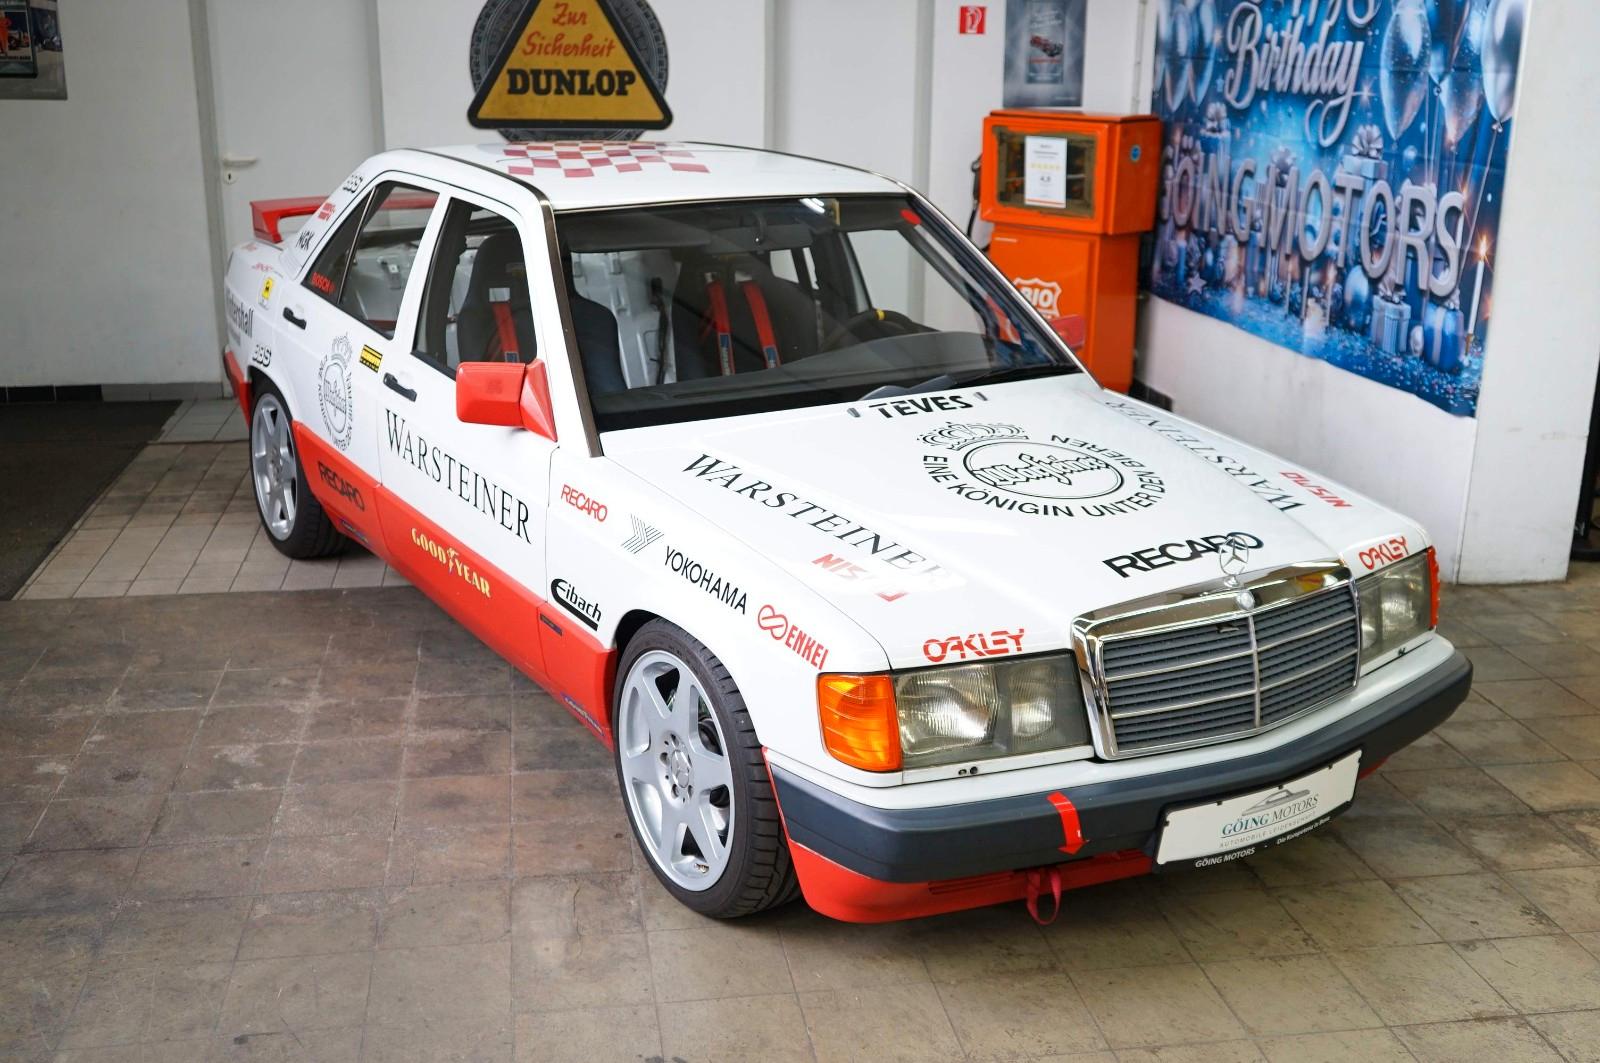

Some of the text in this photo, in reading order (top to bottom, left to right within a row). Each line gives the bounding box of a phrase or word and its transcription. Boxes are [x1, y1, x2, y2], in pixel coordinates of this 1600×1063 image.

[552, 2, 587, 26] Zur
[522, 31, 616, 57] Sicherheit
[507, 69, 635, 96] DUNLOP
[1224, 2, 1364, 147] Birthday
[1259, 163, 1465, 297] MOTORS
[869, 395, 973, 419] TEVES
[318, 461, 364, 511] RECARO
[386, 408, 532, 544] WARSTEINER
[923, 434, 1165, 517] EINE KÖNIGIN UNTER DEN BIEREN
[560, 484, 608, 522] RECARO
[1103, 532, 1264, 578] RECARO
[1358, 535, 1409, 570] OAKLEY
[664, 546, 747, 615] YOKOHAMA
[551, 579, 602, 631] Eibach
[784, 624, 829, 670] ENKEI
[923, 628, 1024, 662] OAKLEY
[1222, 794, 1319, 836] GÖING MOTORS
[1195, 856, 1222, 868] GÖING
[1223, 848, 1255, 862] MOTORS
